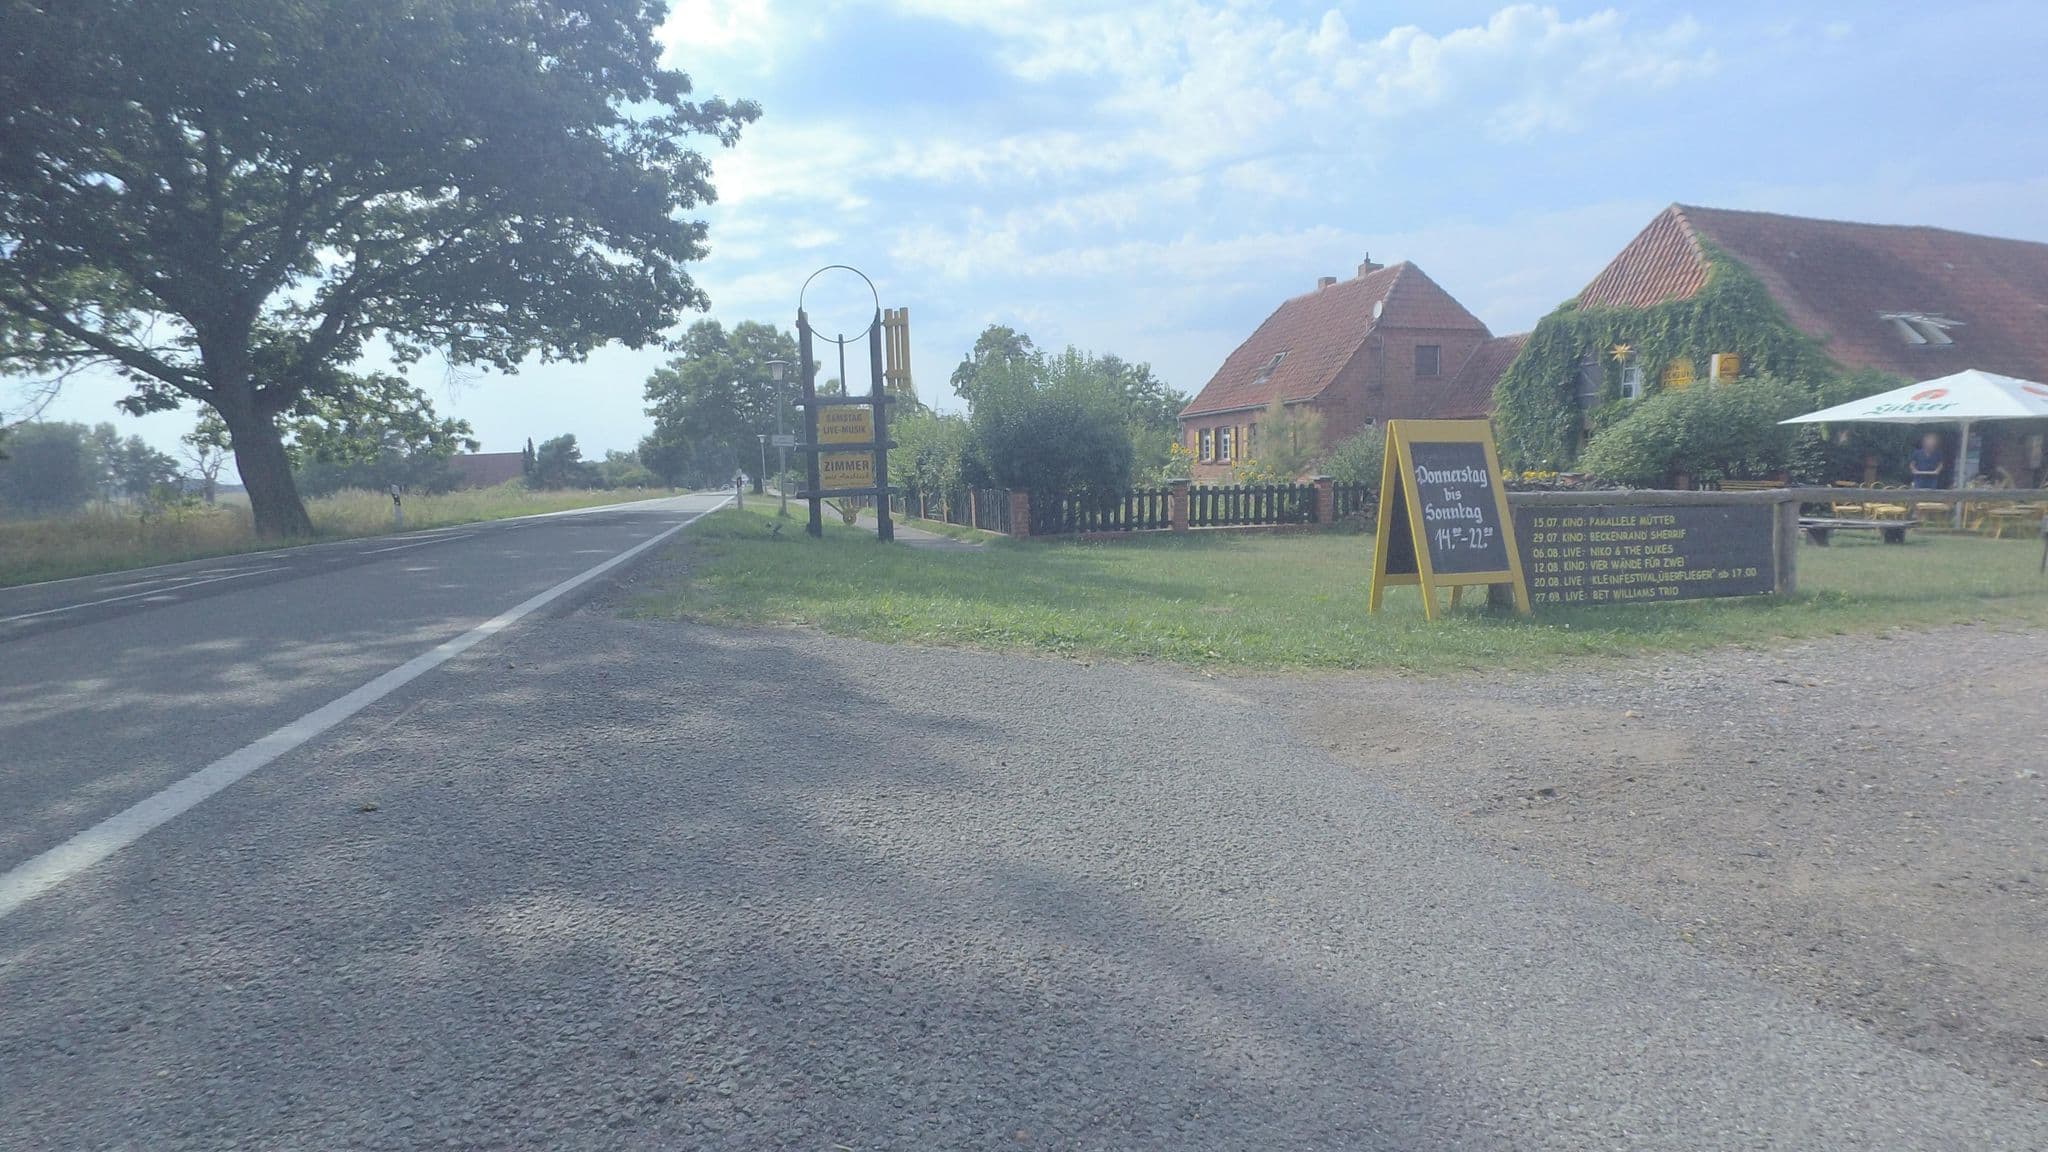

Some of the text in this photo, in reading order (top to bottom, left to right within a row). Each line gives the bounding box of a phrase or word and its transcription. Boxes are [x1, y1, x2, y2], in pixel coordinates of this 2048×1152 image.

[824, 460, 869, 471] ZIMMER
[1415, 465, 1488, 488] Donnerstag
[1443, 486, 1462, 501] bis
[1425, 502, 1483, 524] Sonntag
[1562, 517, 1587, 527] KINO:
[1562, 532, 1586, 542] KINO:
[1589, 530, 1648, 542] BECKENRAND
[1590, 546, 1612, 557] NIKO
[1623, 545, 1642, 555] THE
[1644, 544, 1674, 555] DUKES
[1563, 560, 1588, 572] KINO:
[1590, 559, 1609, 571] VIER
[1644, 556, 1661, 569] FÜR
[1732, 567, 1757, 578] 17.00
[1565, 590, 1588, 601] LIVE:
[1592, 589, 1610, 600] BET
[1612, 587, 1656, 599] WILLIAMS
[1658, 586, 1680, 597] TRIO
